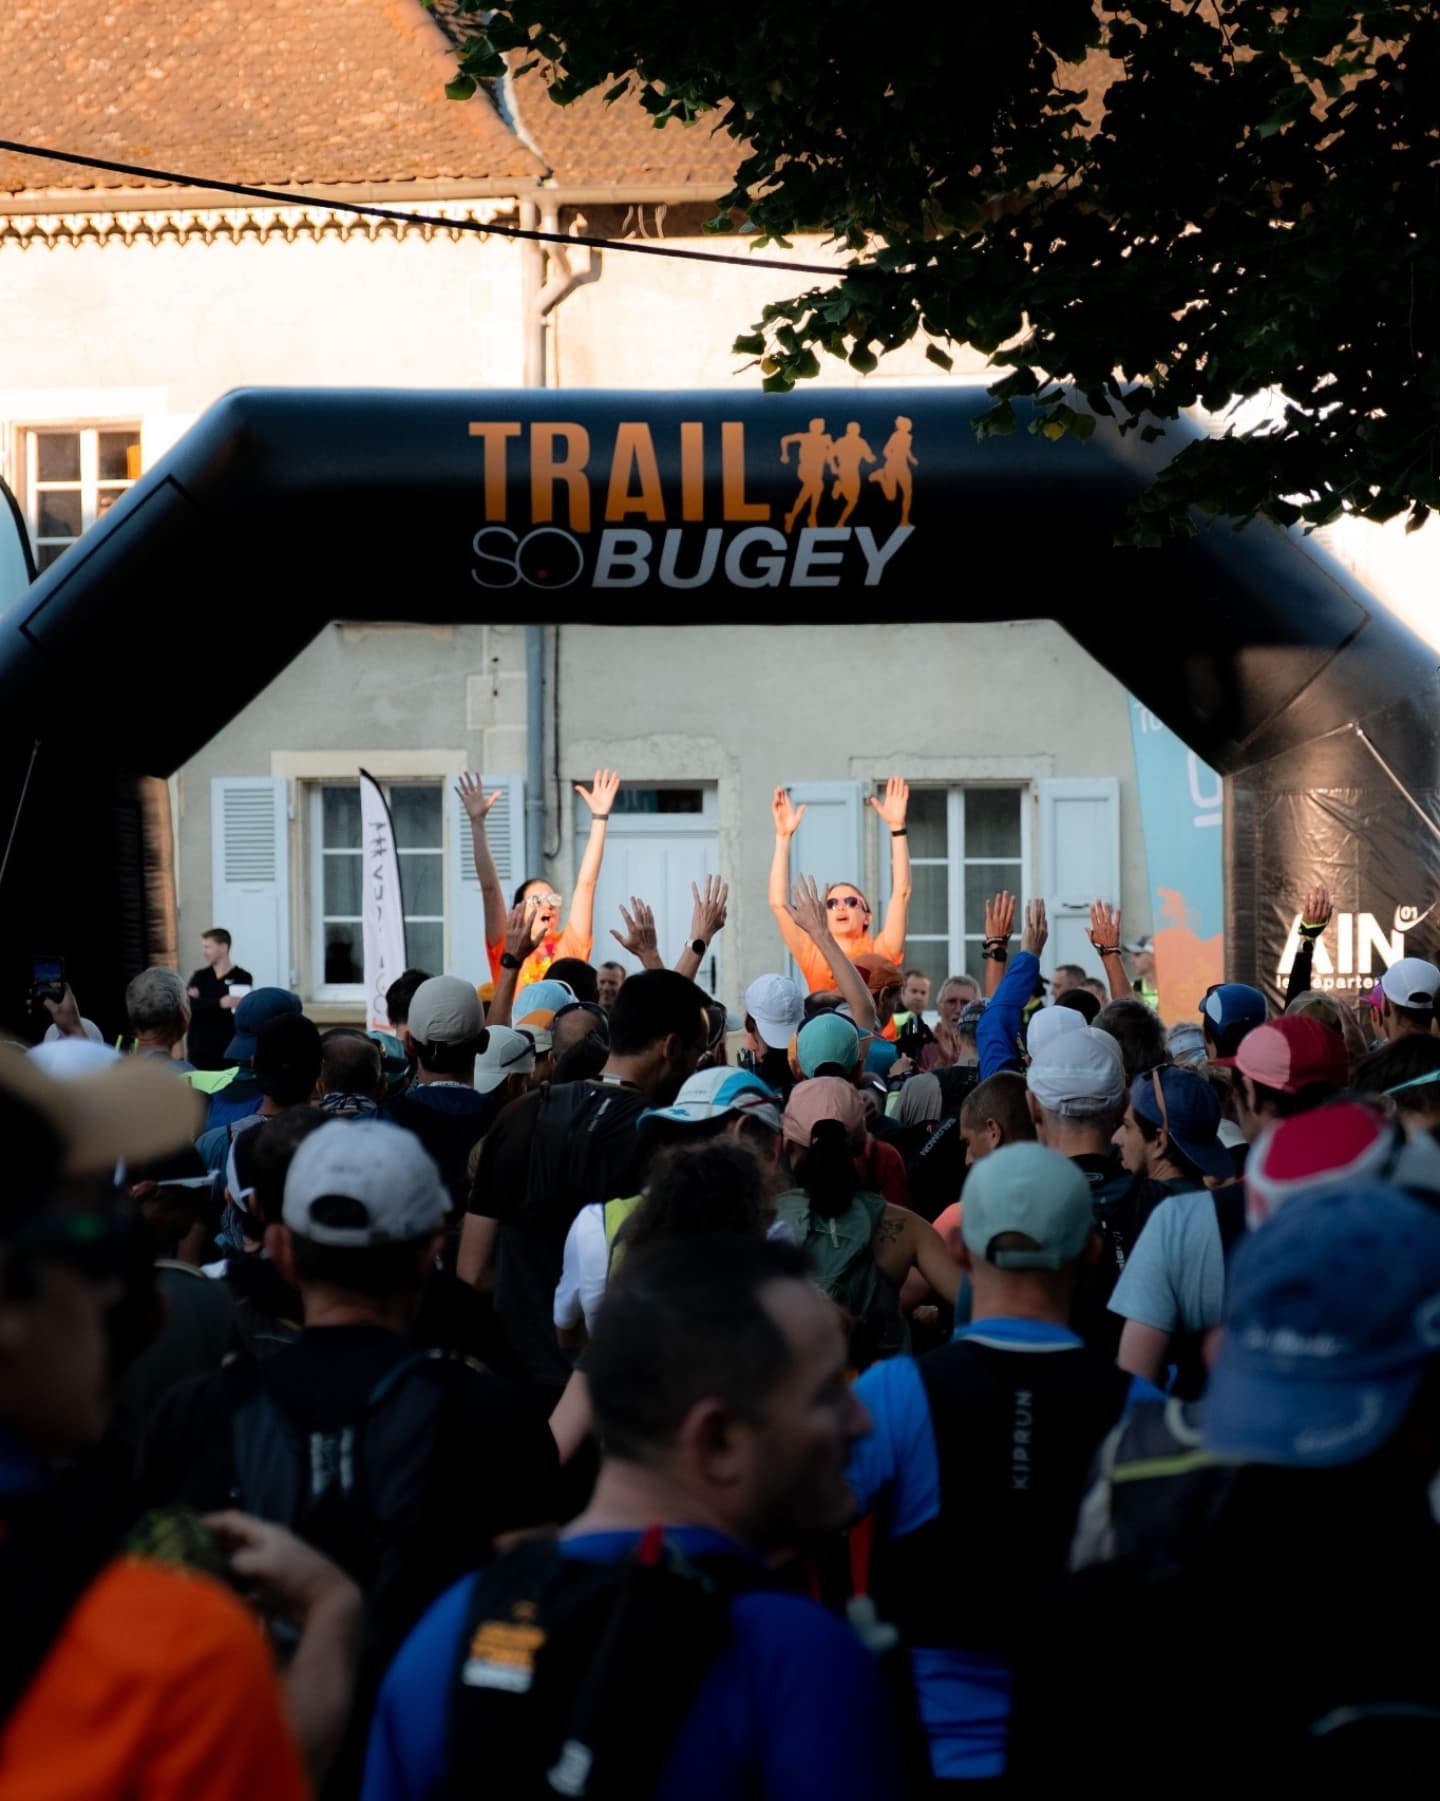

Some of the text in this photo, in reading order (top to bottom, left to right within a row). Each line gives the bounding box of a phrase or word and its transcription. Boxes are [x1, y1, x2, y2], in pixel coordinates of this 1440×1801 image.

[468, 421, 771, 532] TRAIL
[471, 526, 916, 589] SO BUGEY
[1276, 912, 1405, 974] AIN
[1400, 905, 1418, 920] 01
[1012, 1387, 1033, 1490] KIPRUN
